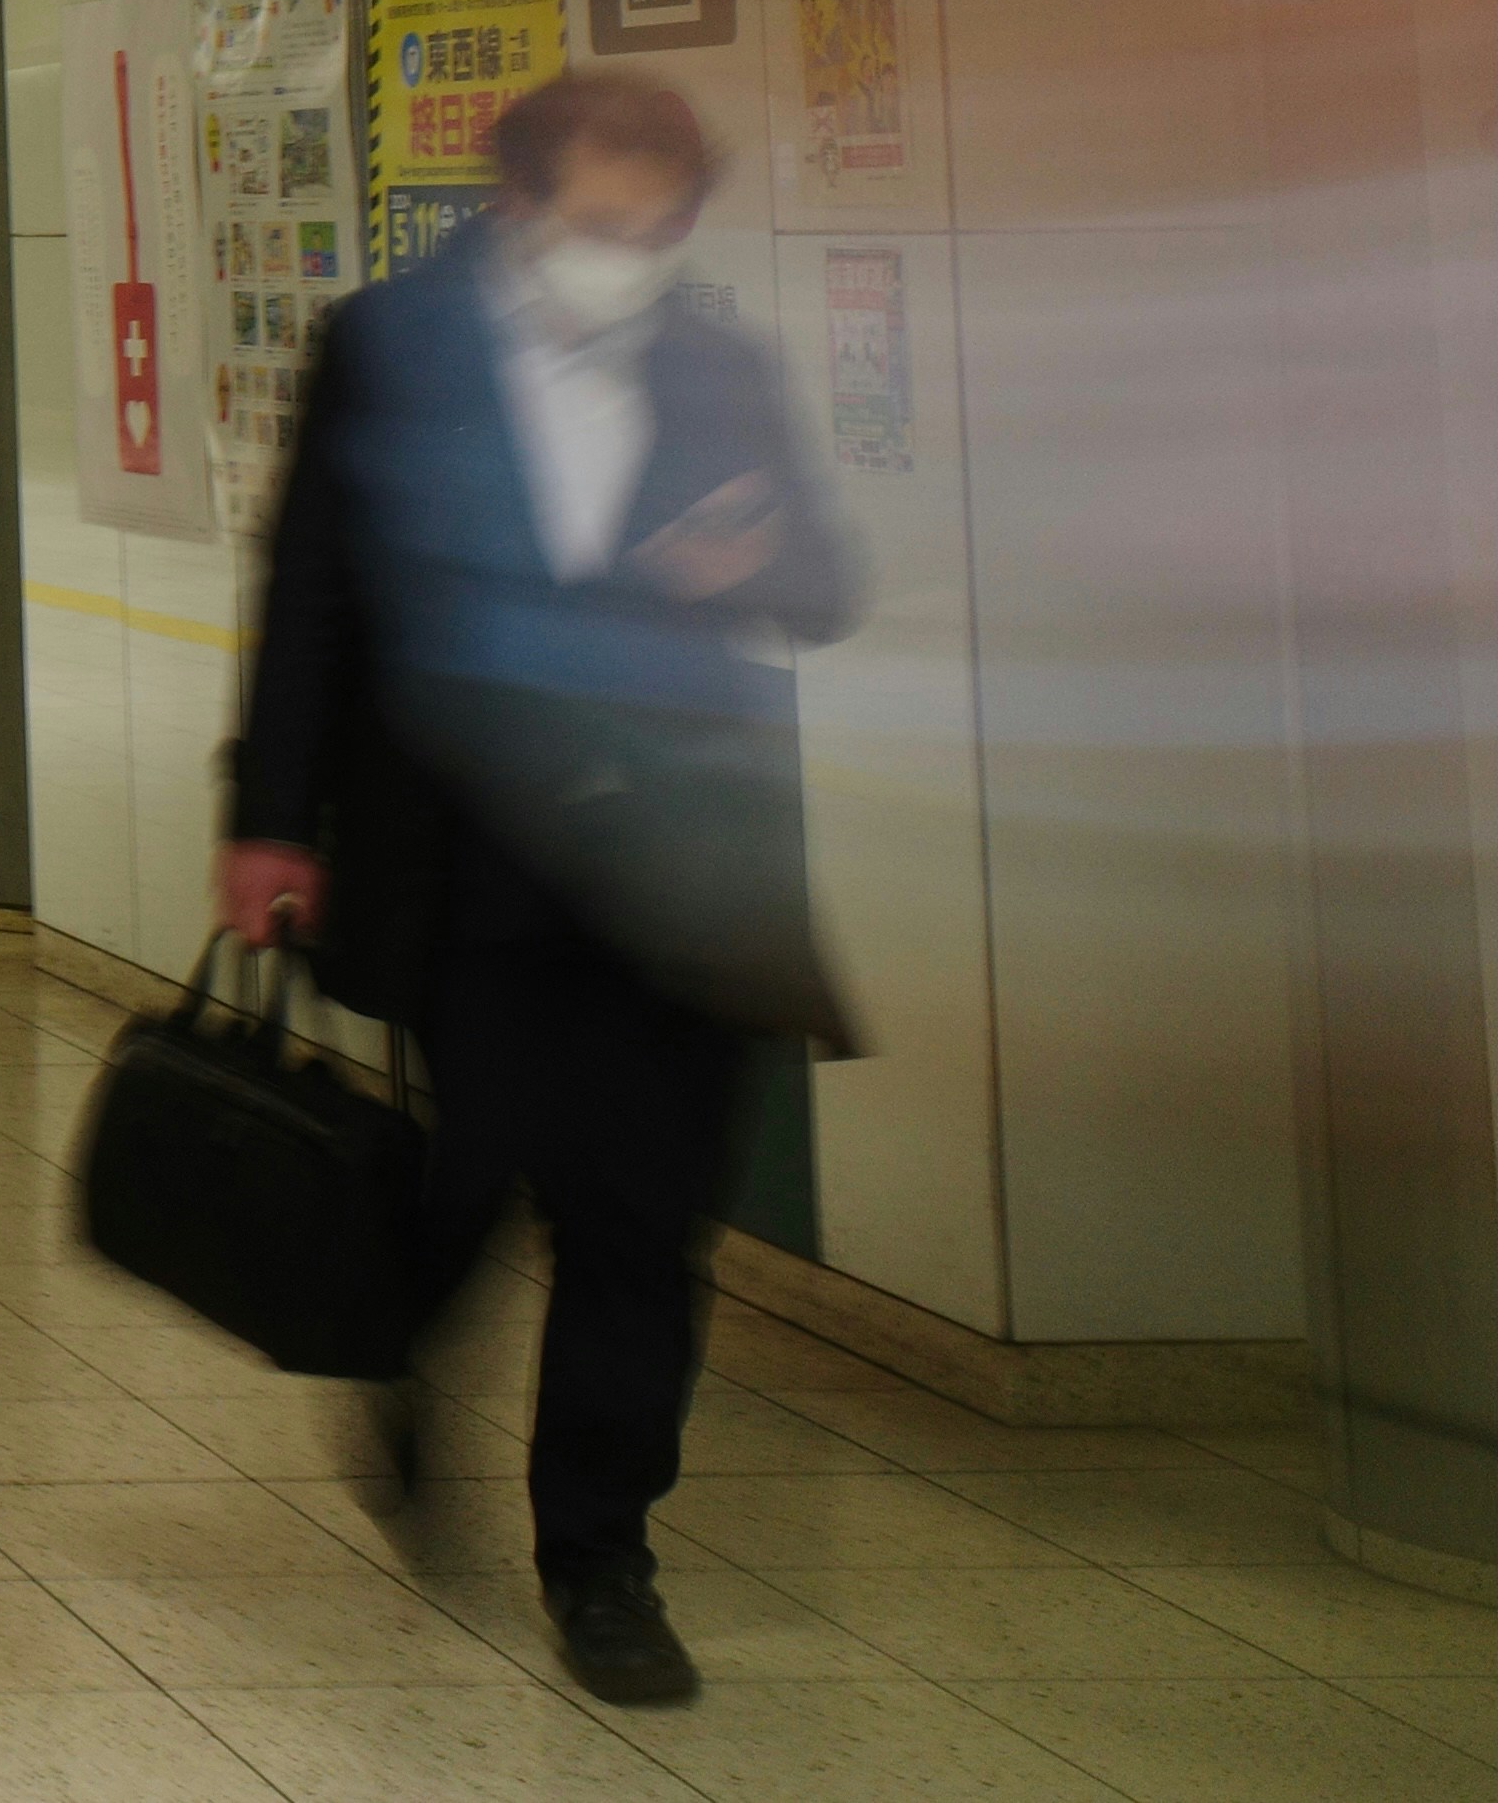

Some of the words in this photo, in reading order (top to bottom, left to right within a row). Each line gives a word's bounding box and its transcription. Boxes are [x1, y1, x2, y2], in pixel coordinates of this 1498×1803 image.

[427, 25, 503, 83] 東西線
[410, 87, 524, 156] 終日運
[392, 213, 409, 256] 5
